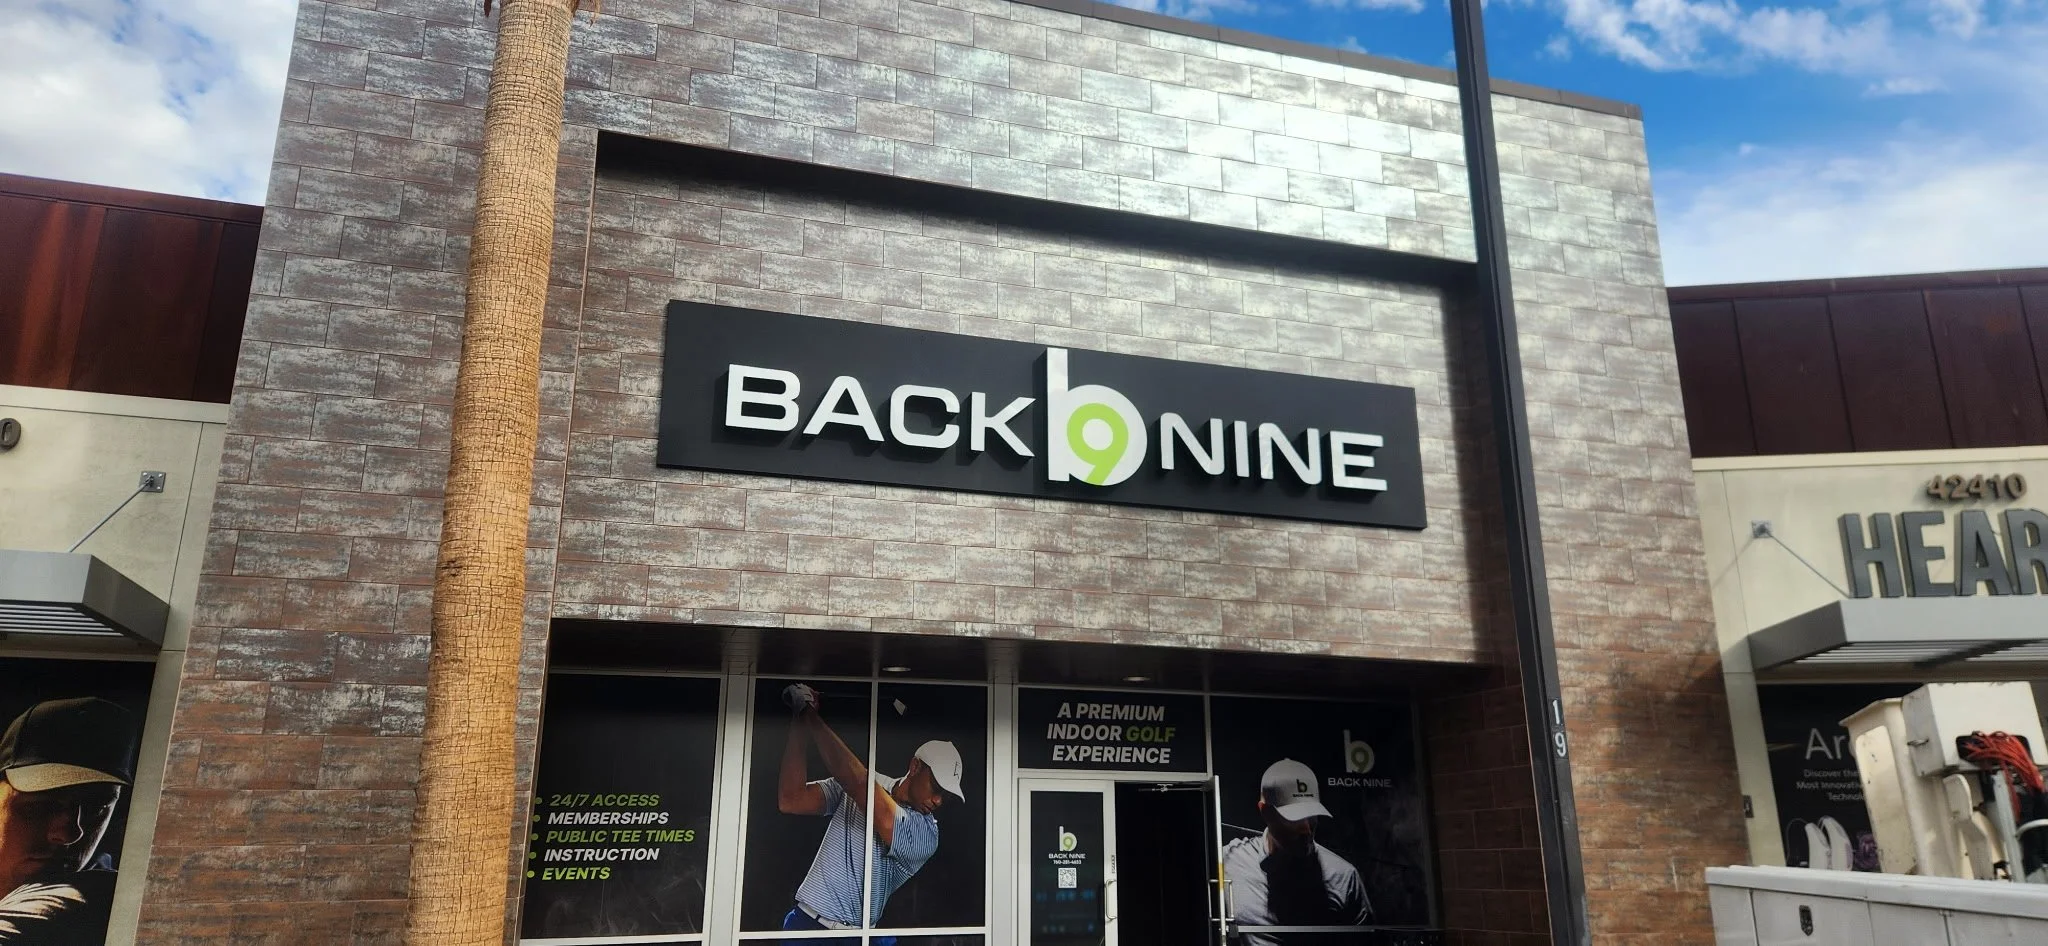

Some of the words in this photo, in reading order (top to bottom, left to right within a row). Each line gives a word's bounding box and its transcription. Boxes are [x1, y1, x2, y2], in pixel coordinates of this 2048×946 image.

[725, 364, 1034, 458] BACK
[1161, 412, 1388, 492] NINE
[1927, 472, 2028, 501] 42410
[1838, 508, 2048, 598] HEAR
[1057, 702, 1072, 718] A
[1075, 702, 1165, 721] PREMIUM
[1046, 723, 1122, 742] INDOOR
[1126, 726, 1176, 743] GOLF
[1805, 728, 1855, 760] Ar
[1052, 745, 1171, 764] EXPERIENCE
[1327, 777, 1361, 788] BACK
[1362, 778, 1392, 788] NINE
[550, 794, 590, 808] 24/7
[591, 794, 660, 807] ACCESS
[547, 812, 669, 825] MEMBERSHIPS
[545, 830, 608, 843] PUBLIC
[611, 830, 642, 843] TEE
[645, 829, 695, 843] TIMES
[543, 848, 660, 862] INSTRUCTION
[541, 867, 611, 881] EVENTS
